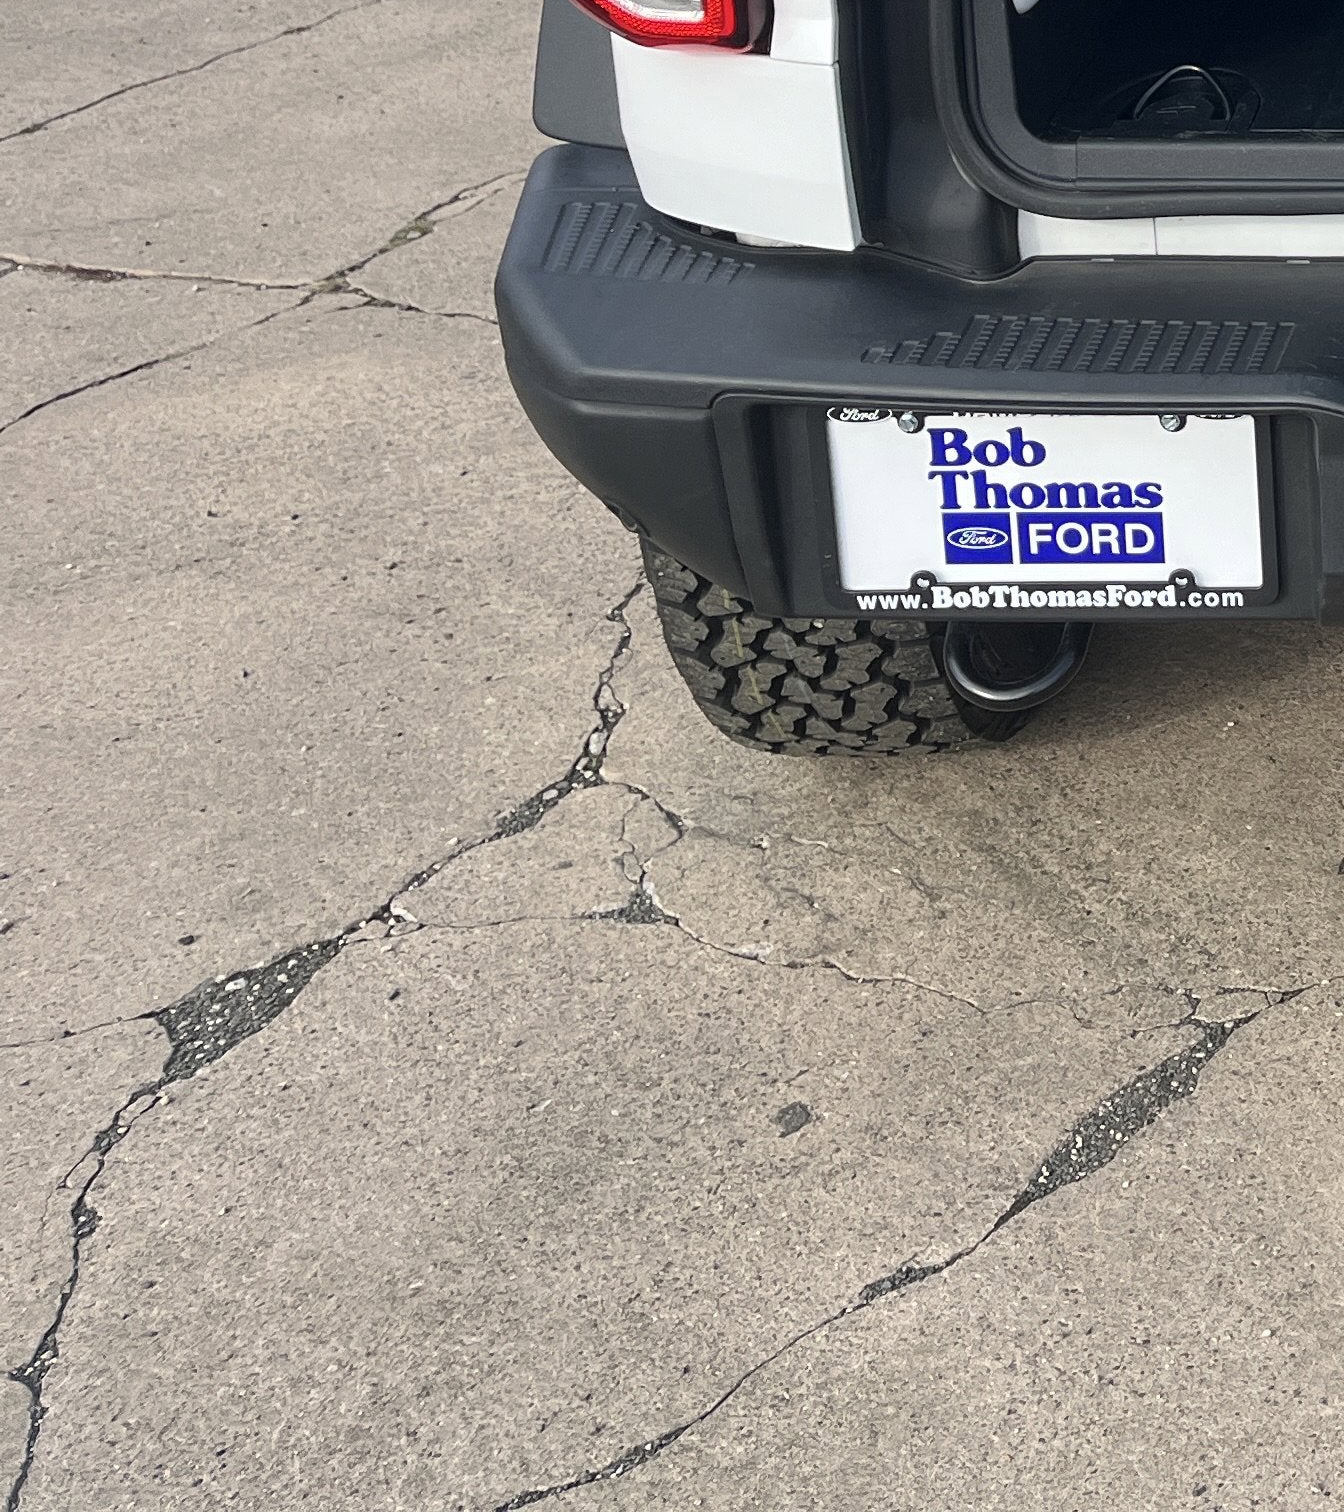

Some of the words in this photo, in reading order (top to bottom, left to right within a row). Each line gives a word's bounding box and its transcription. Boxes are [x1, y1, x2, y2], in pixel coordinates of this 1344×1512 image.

[927, 427, 1047, 467] Bob
[928, 470, 1164, 510] Thomas
[958, 529, 997, 546] Ford
[1029, 522, 1155, 555] FORD
[856, 584, 1244, 611] www.BobThomasFord.com
